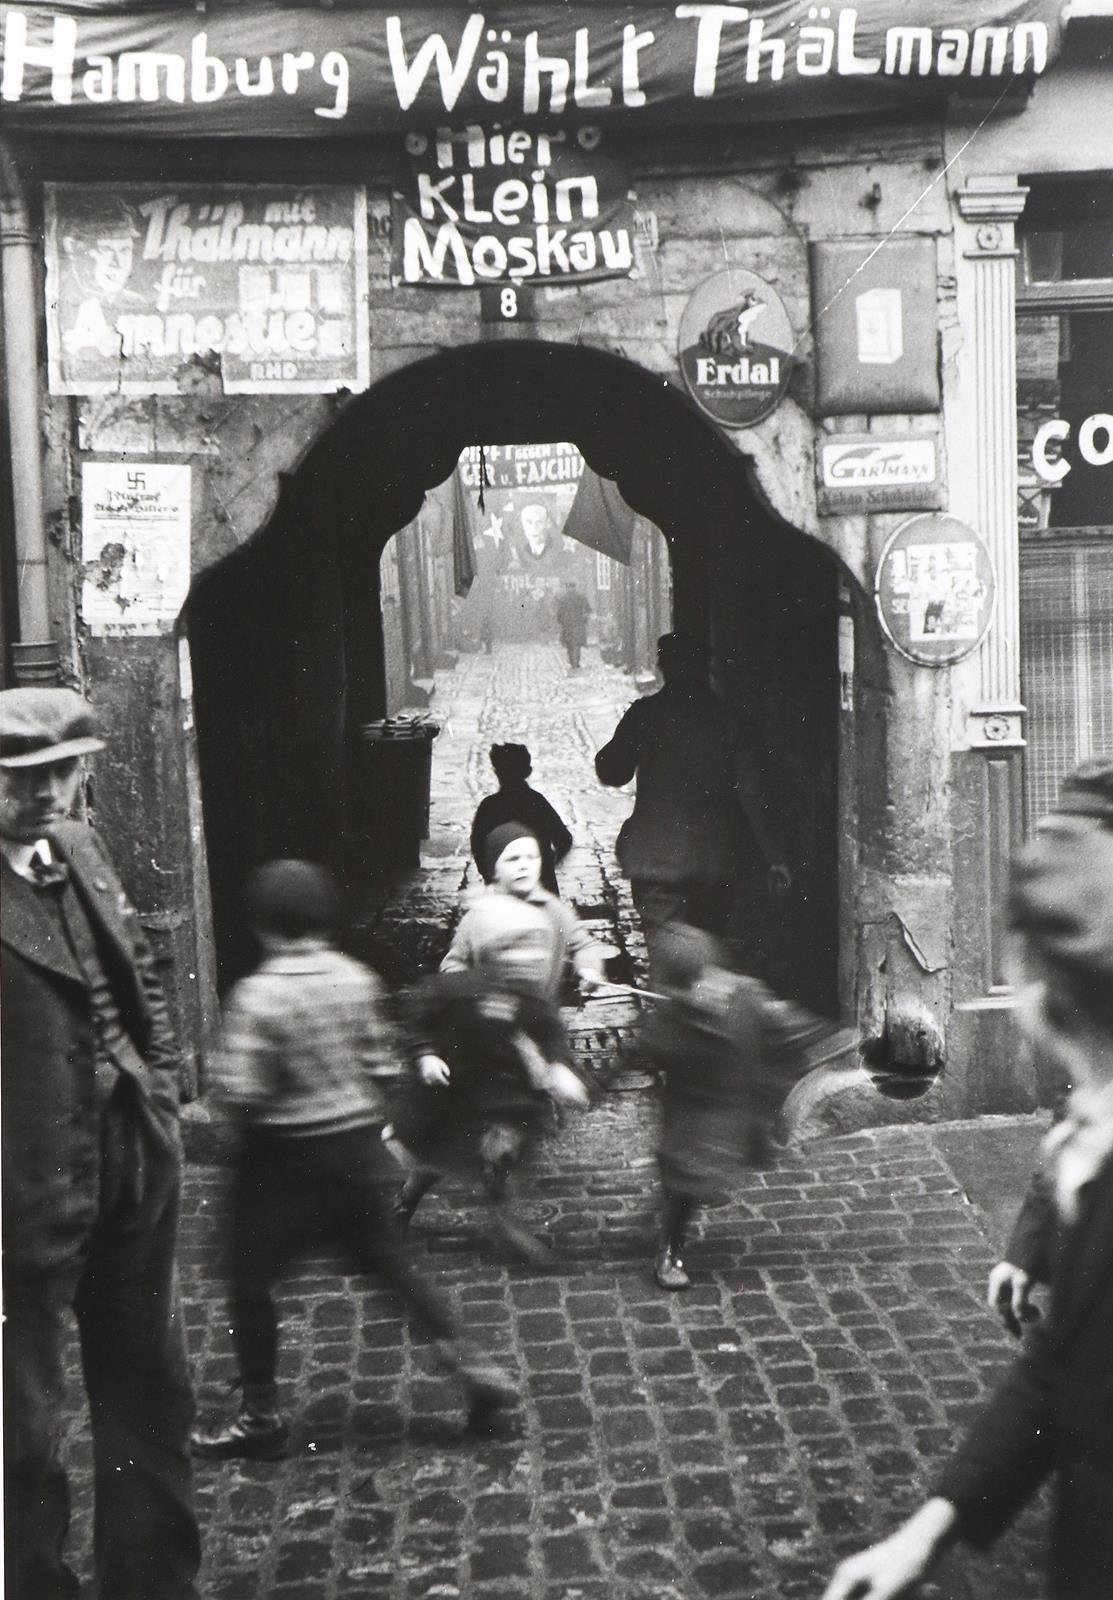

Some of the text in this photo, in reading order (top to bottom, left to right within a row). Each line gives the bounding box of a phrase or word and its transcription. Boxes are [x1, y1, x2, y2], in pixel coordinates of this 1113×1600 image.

[2, 11, 350, 119] Hamburg
[435, 122, 566, 169] Hier
[138, 194, 353, 263] Thälmann
[403, 217, 632, 285] Moskau
[153, 262, 206, 312] für
[500, 287, 518, 318] 8
[696, 357, 780, 386] Erdal
